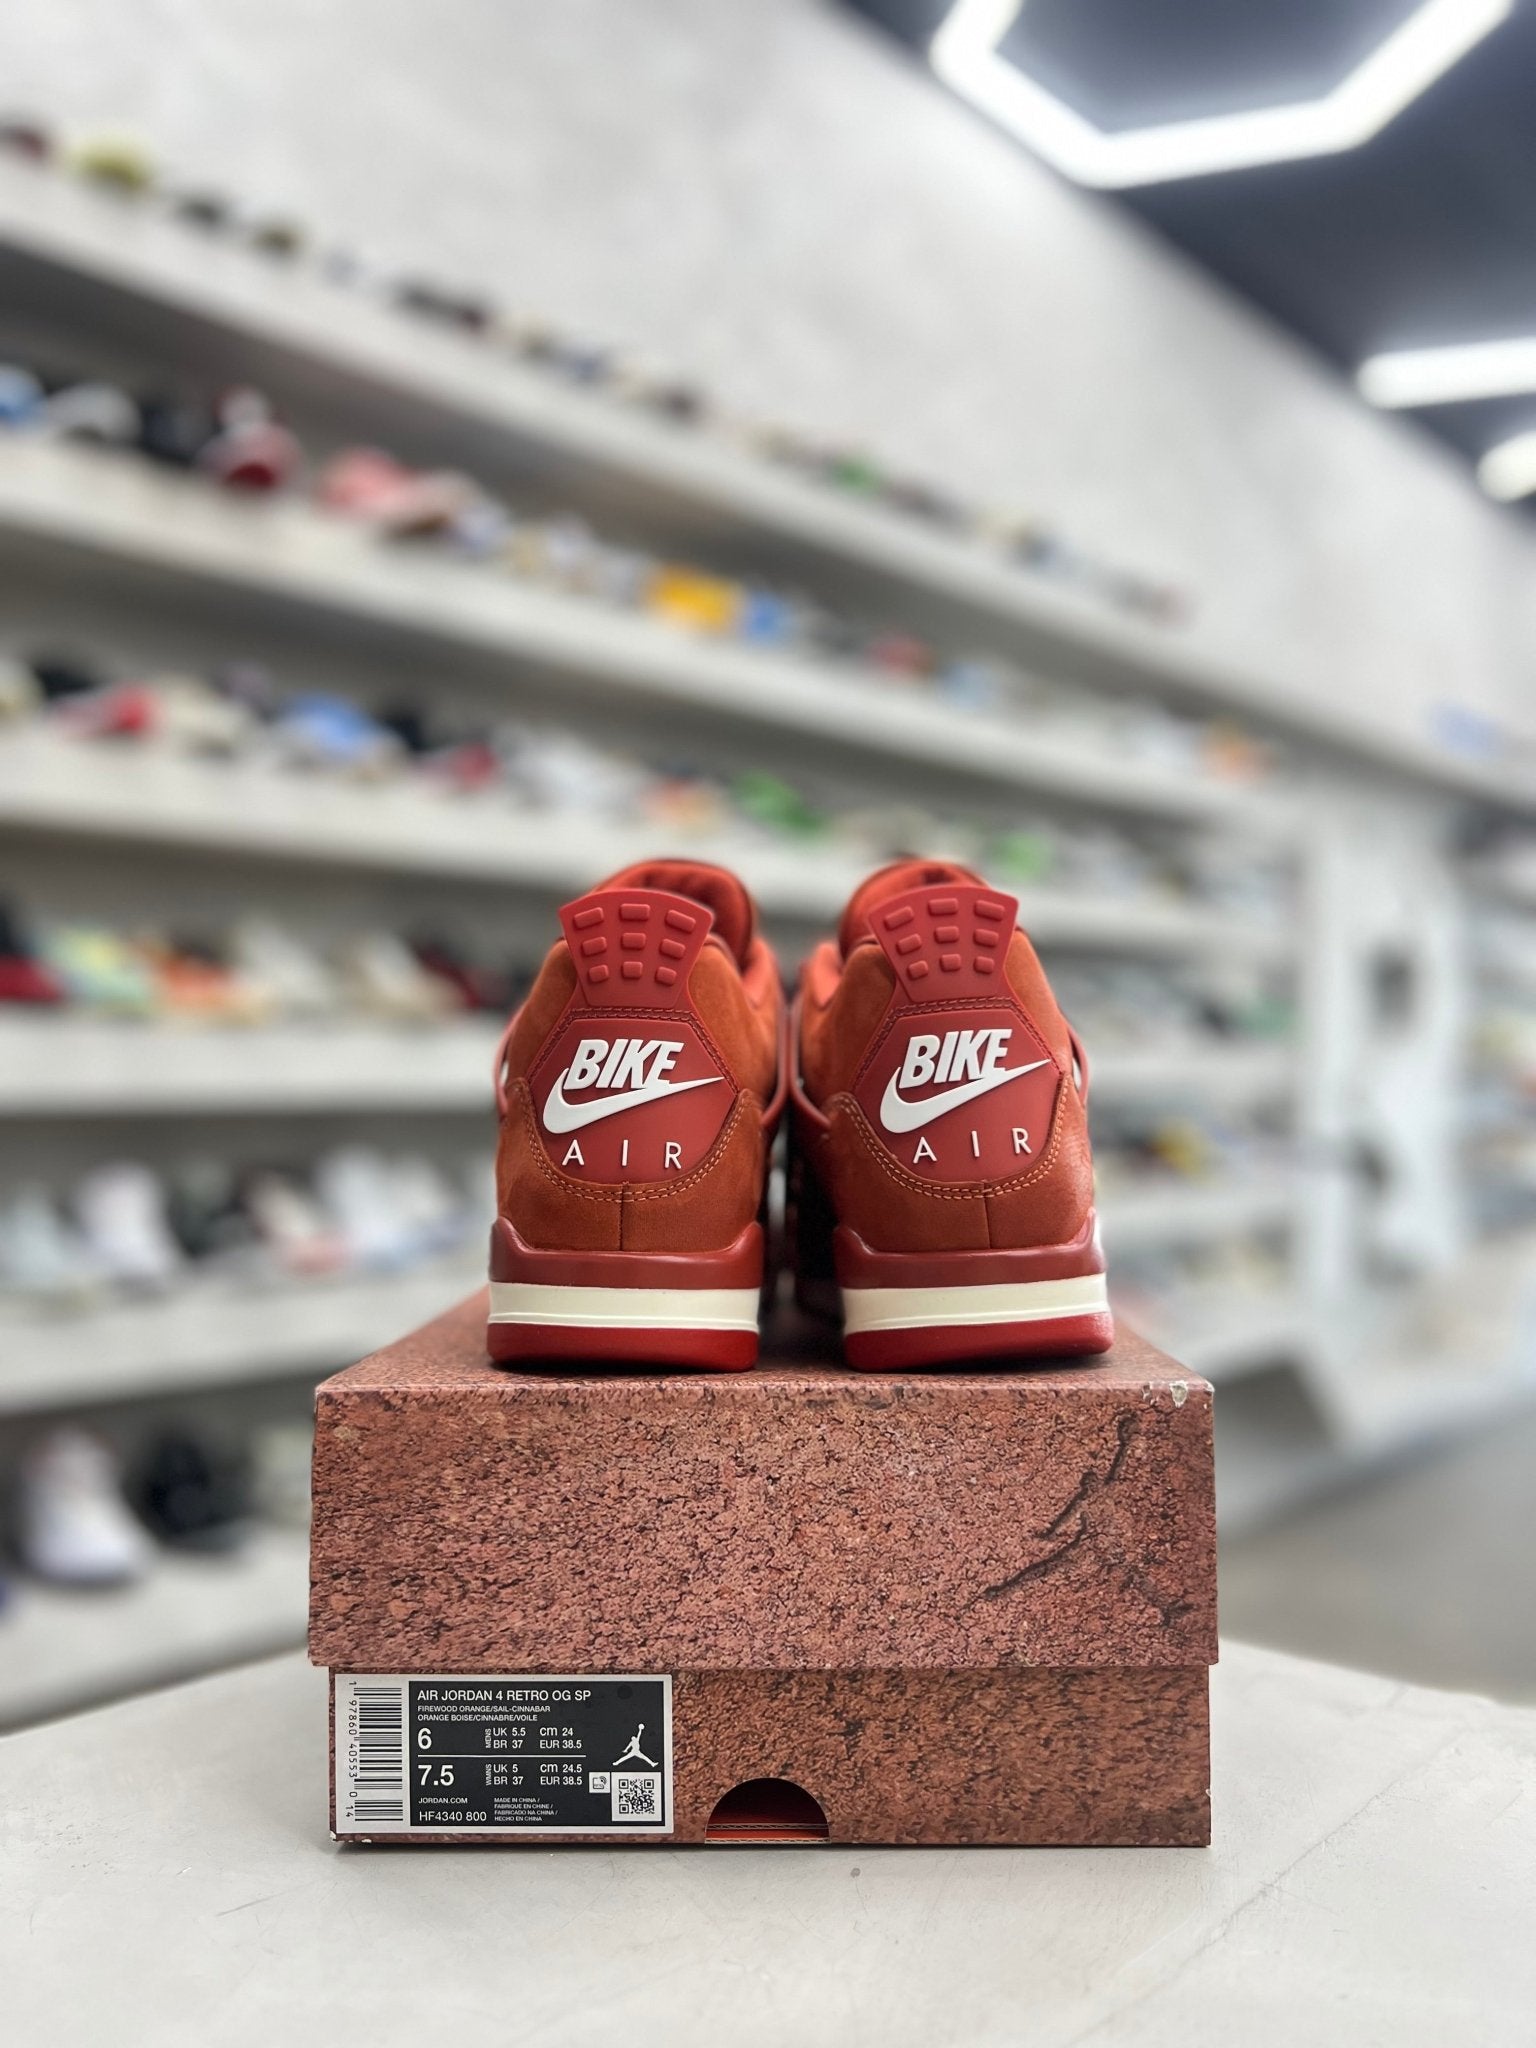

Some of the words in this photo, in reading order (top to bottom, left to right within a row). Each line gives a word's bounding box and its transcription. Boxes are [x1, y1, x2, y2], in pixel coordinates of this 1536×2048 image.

[899, 1028, 1012, 1089] BIKE
[562, 1038, 684, 1090] BIKE
[913, 1126, 1033, 1165] AIR
[562, 1139, 683, 1170] AIR
[417, 1690, 438, 1701] AIR
[441, 1690, 493, 1701] JORDAN
[495, 1690, 503, 1701] 4
[506, 1690, 549, 1701] RETRO
[551, 1690, 571, 1701] OG
[574, 1690, 591, 1701] SP
[459, 1705, 551, 1713] ORANGE/SAIL-CINNABAR
[493, 1727, 508, 1737] UK
[512, 1727, 526, 1737] 5.5
[562, 1727, 574, 1737] 24
[417, 1728, 432, 1750] 6
[493, 1739, 507, 1749] BR
[512, 1739, 523, 1749] 37
[540, 1739, 560, 1749] EUR
[562, 1739, 582, 1749] 38.5
[493, 1764, 508, 1773] UK
[512, 1764, 518, 1773] 5
[562, 1764, 582, 1773] 24.5
[417, 1764, 455, 1786] 7.5
[493, 1776, 508, 1786] BR
[512, 1776, 524, 1786] 37
[540, 1776, 560, 1786] EUR
[562, 1776, 582, 1786] 38.5
[419, 1811, 463, 1821] HF4340
[465, 1811, 487, 1821] 800
